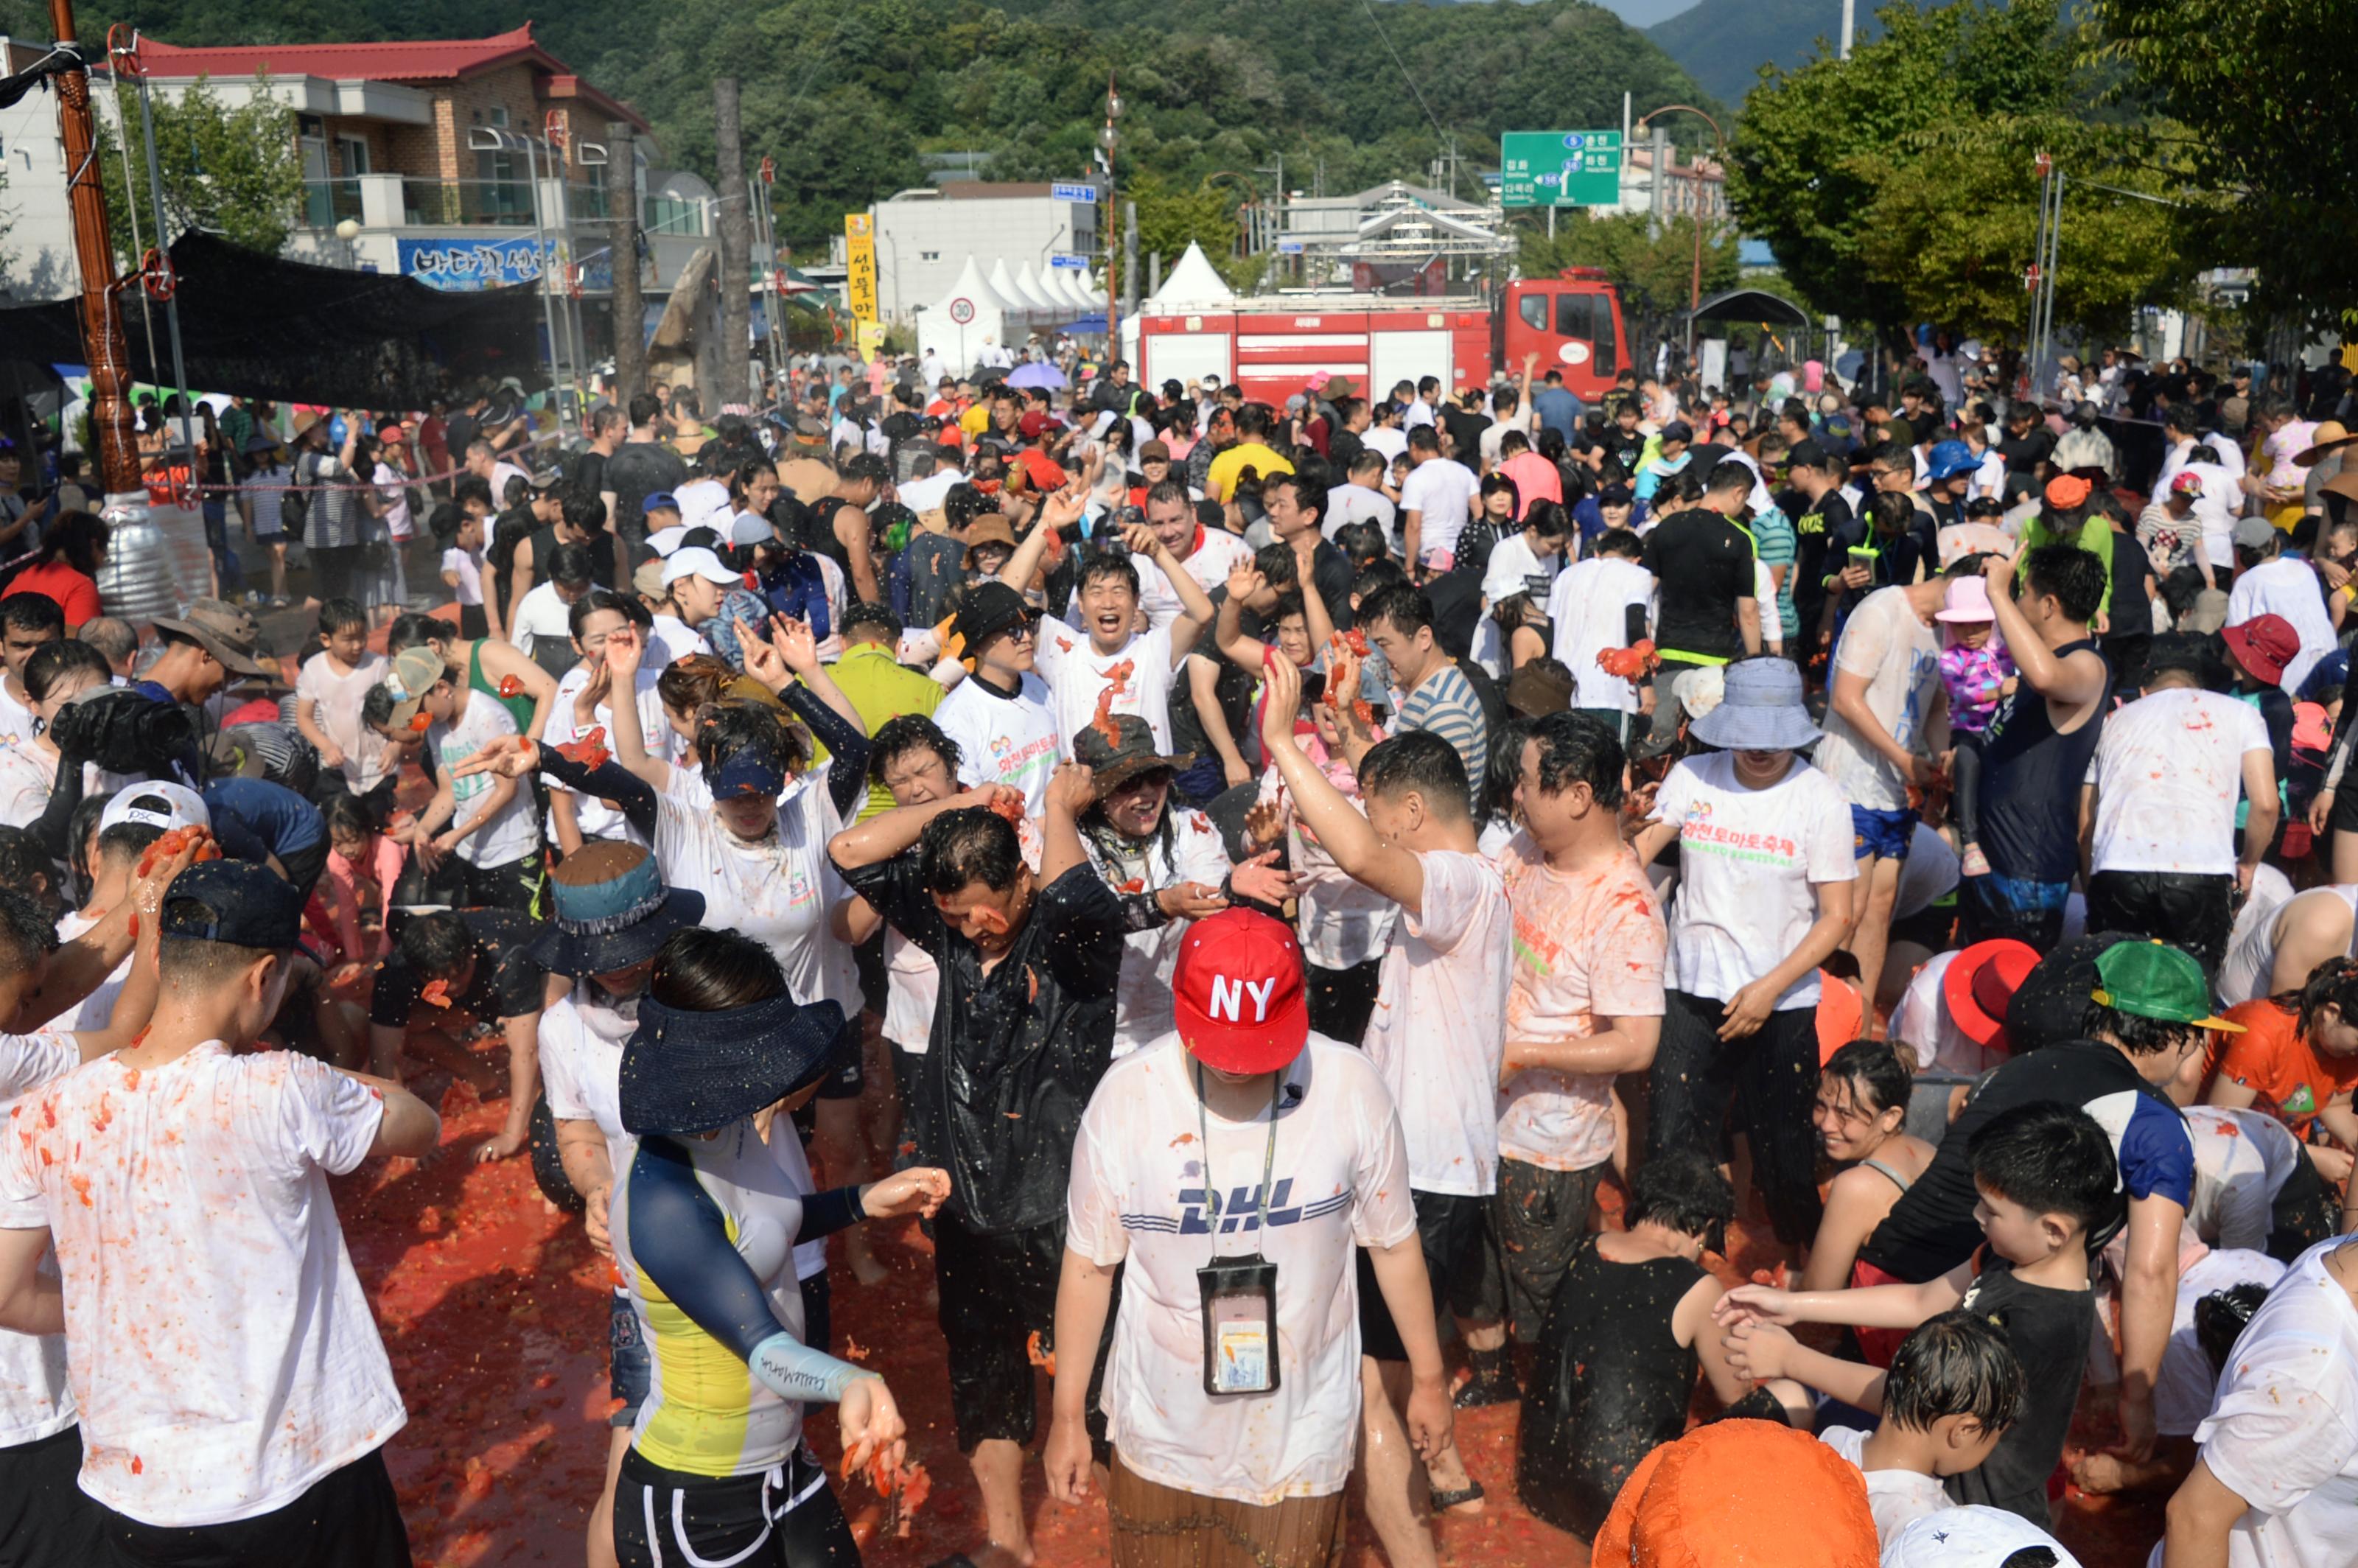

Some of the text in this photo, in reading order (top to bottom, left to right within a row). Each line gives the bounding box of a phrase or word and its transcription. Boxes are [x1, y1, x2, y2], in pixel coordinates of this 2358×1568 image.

[956, 304, 970, 318] 30
[1209, 973, 1276, 1022] NY
[1178, 1177, 1303, 1235] DHL
